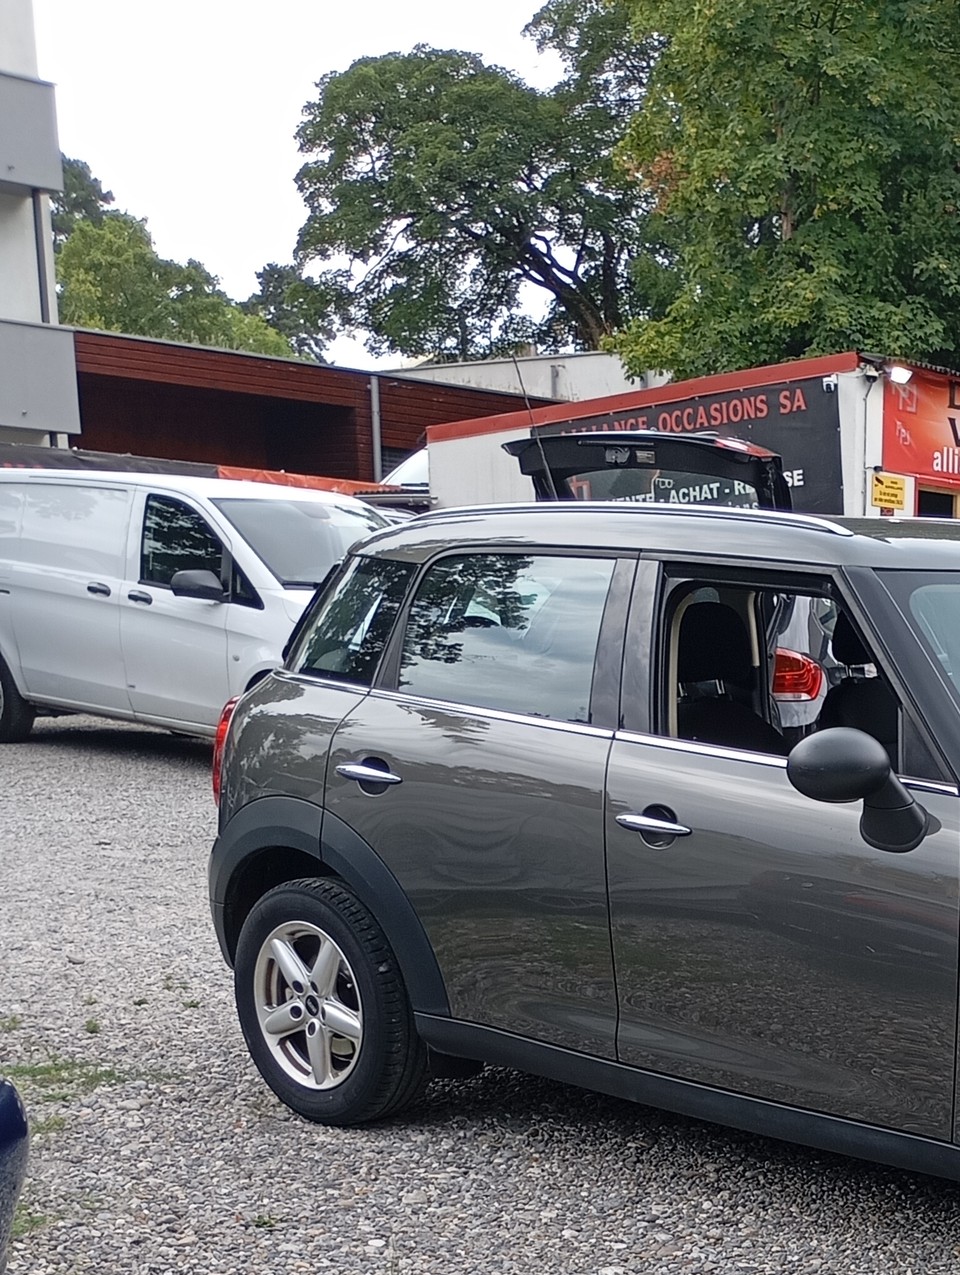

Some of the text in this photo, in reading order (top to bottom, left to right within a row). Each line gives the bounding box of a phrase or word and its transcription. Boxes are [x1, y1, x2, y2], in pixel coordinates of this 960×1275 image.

[658, 394, 768, 433] OCCASIONS
[779, 388, 806, 414] SA
[669, 482, 720, 504] ACHAT
